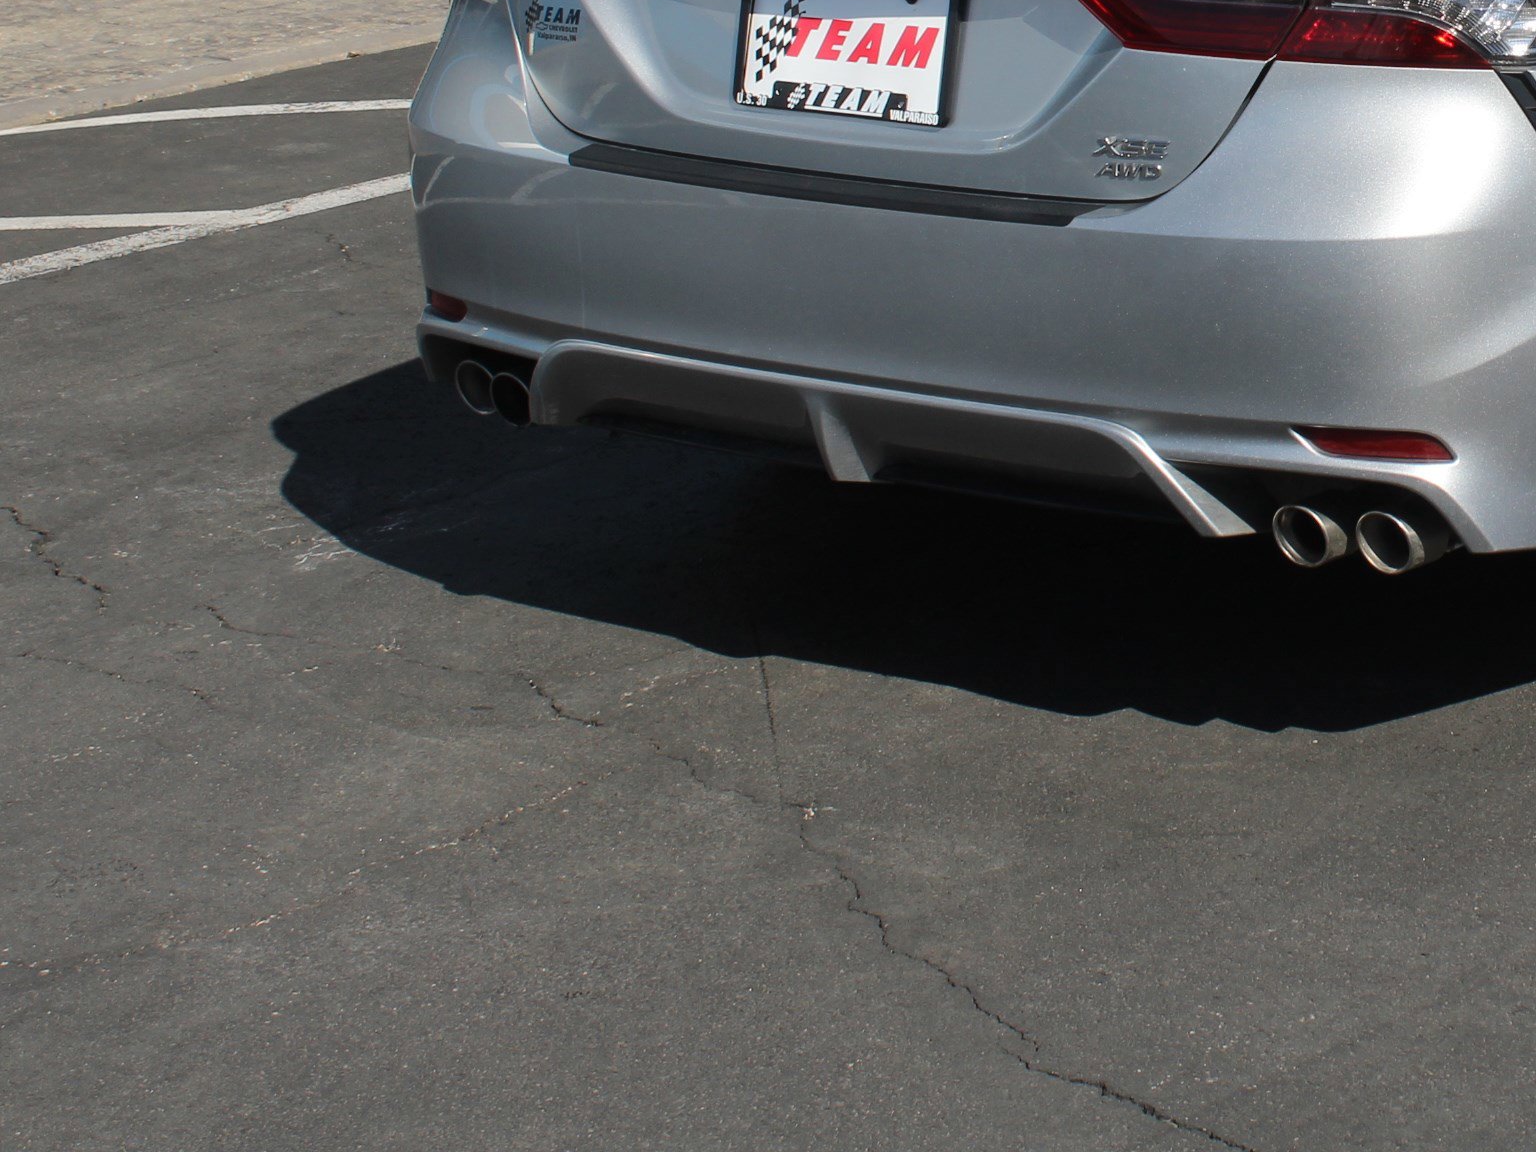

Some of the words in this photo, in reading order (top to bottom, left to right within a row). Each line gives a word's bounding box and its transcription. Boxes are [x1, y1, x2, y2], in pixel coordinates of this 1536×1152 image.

[535, 5, 581, 25] TEAM
[786, 16, 940, 69] TEAM
[736, 92, 755, 105] U.S.
[756, 94, 768, 107] 30
[804, 82, 891, 115] TEAM
[889, 109, 940, 126] VALPARAISO
[1094, 162, 1162, 178] AWD
